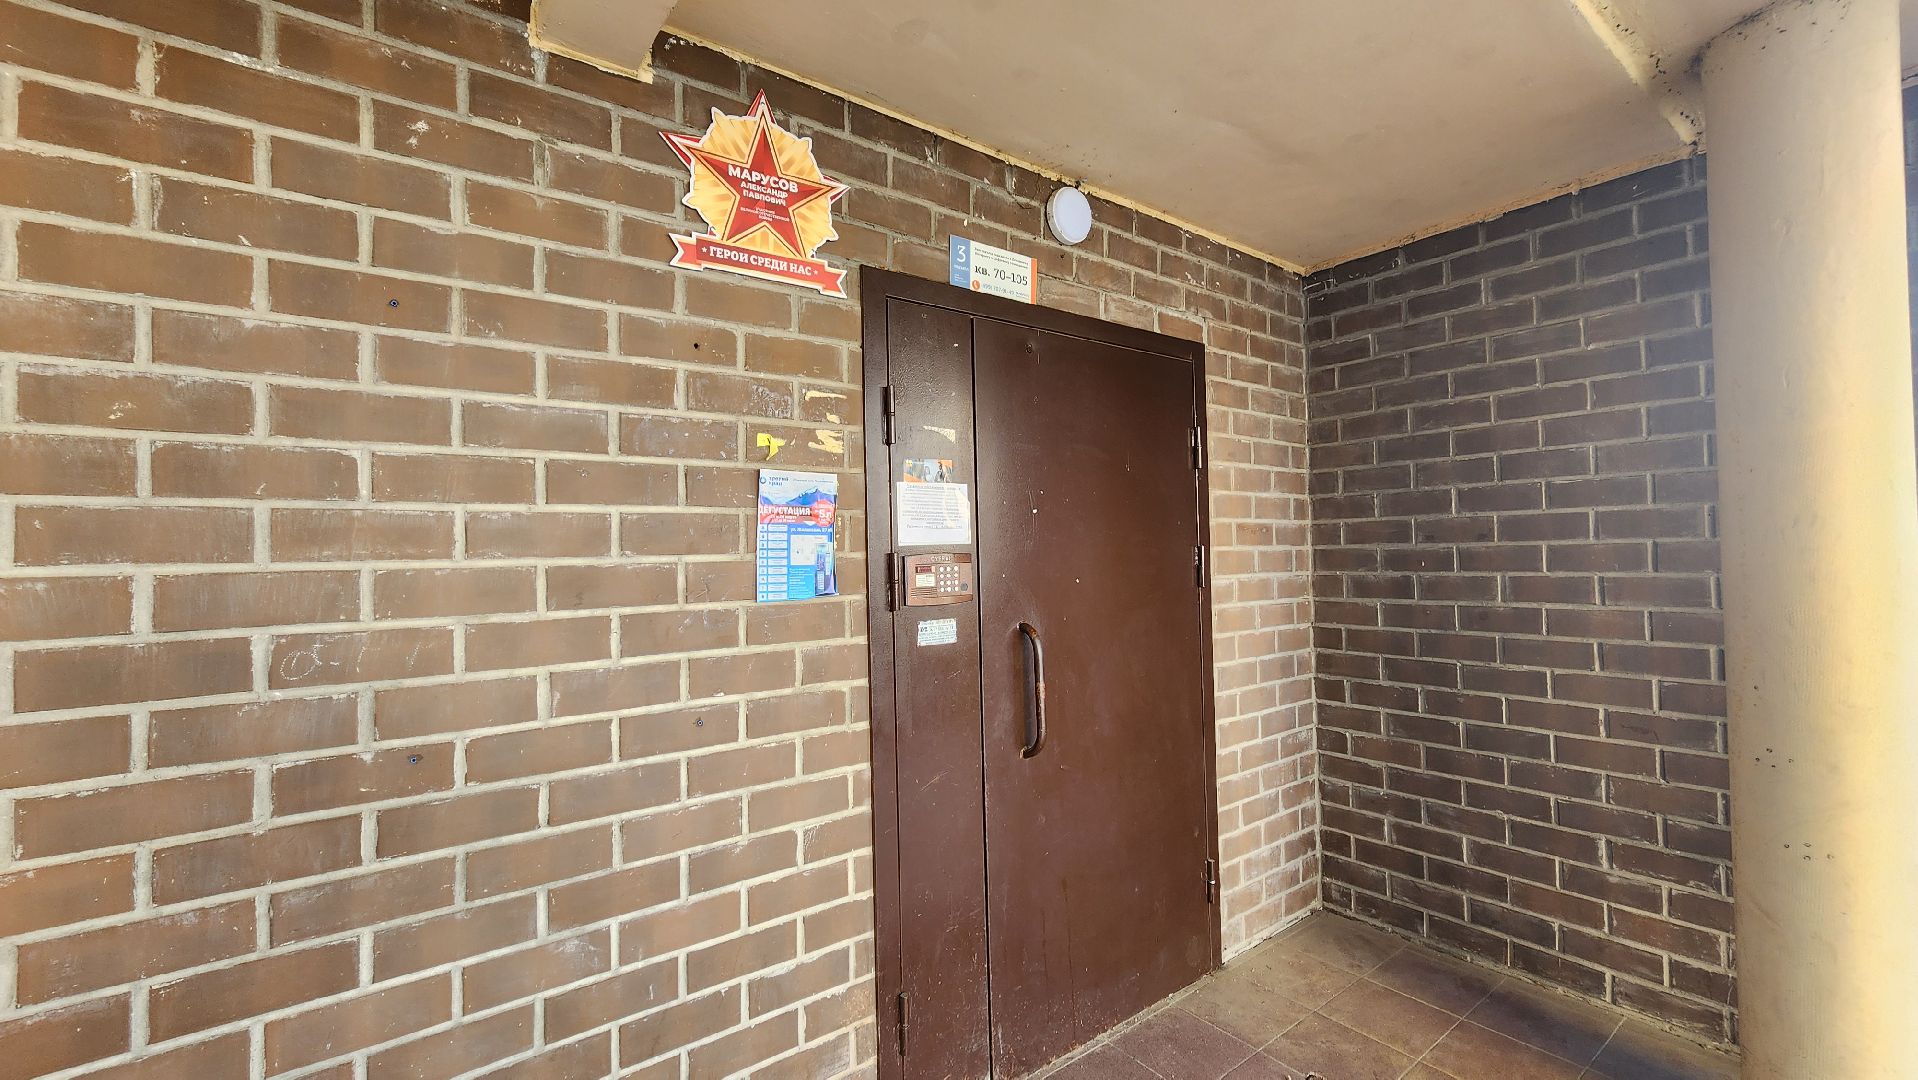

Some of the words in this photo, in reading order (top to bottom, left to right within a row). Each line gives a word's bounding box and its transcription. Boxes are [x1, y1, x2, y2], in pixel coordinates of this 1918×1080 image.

[728, 164, 799, 193] МАРУСОВ
[740, 181, 789, 199] АЛЕКСАНДР
[743, 189, 786, 207] ПАВЛОВИЧ
[709, 245, 749, 264] ГЕРОИ
[750, 254, 788, 271] СРЕДИ
[789, 263, 812, 276] НАС
[956, 244, 966, 263] 3
[974, 265, 990, 277] кв.
[759, 506, 811, 517] ДЕГУСТАЦИЯ
